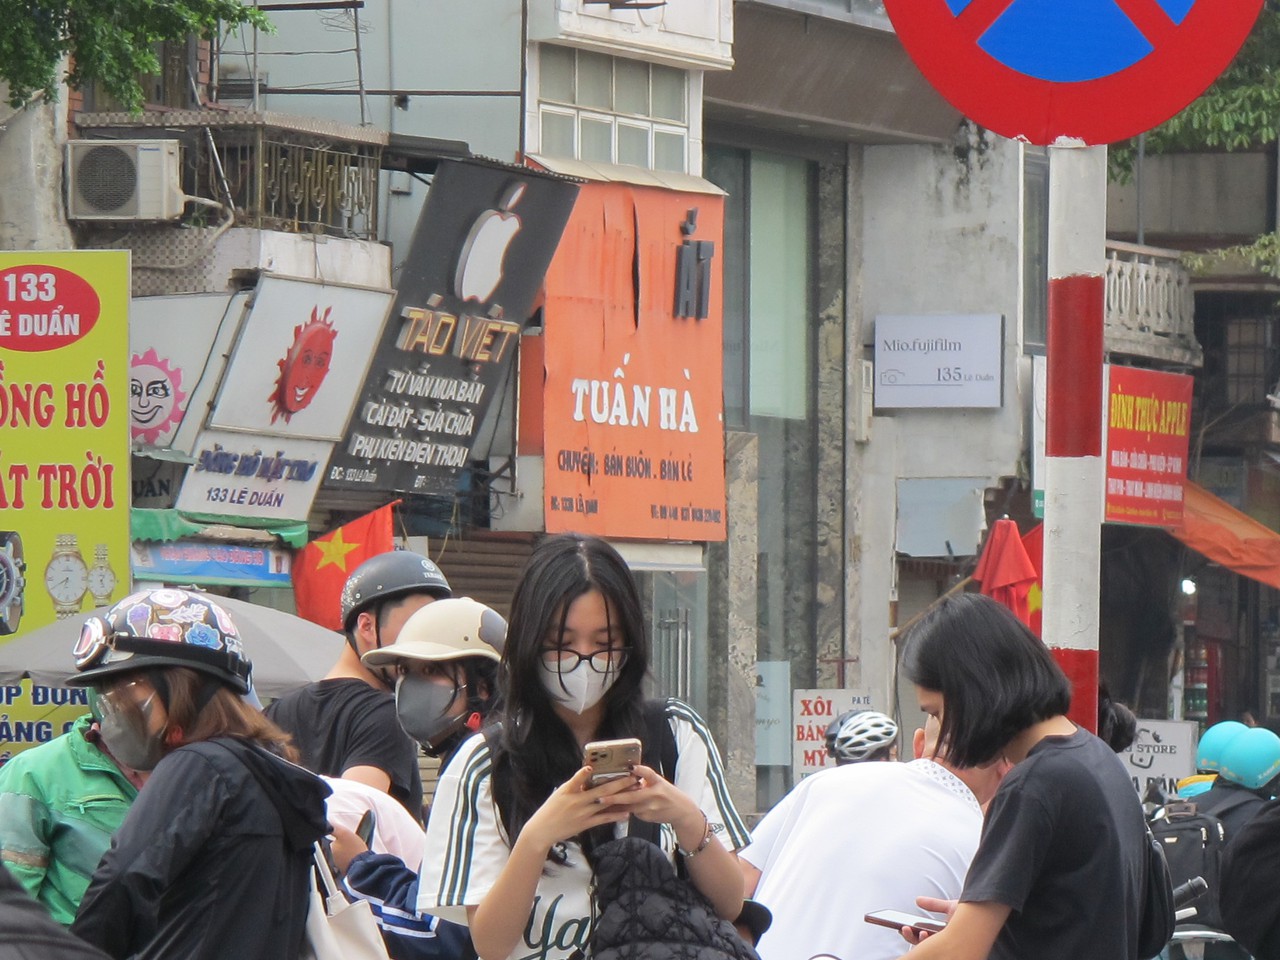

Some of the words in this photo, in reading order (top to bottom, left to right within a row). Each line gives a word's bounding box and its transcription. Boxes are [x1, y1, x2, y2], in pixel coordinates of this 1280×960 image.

[4, 273, 57, 302] 133
[19, 305, 80, 336] DUẨN
[883, 338, 961, 355] Mio.fujifilm
[431, 377, 459, 401] MUA
[936, 367, 962, 382] 135
[65, 359, 110, 429] HỒ
[572, 352, 651, 428] TUẤN
[659, 368, 699, 433] HÀ
[1159, 400, 1188, 436] APPLE
[604, 446, 623, 476] BÁN
[37, 450, 114, 510] TRỜI
[206, 486, 229, 502] 133
[229, 487, 248, 505] LÊ
[800, 696, 832, 716] XÔI
[1137, 744, 1177, 754] STORE
